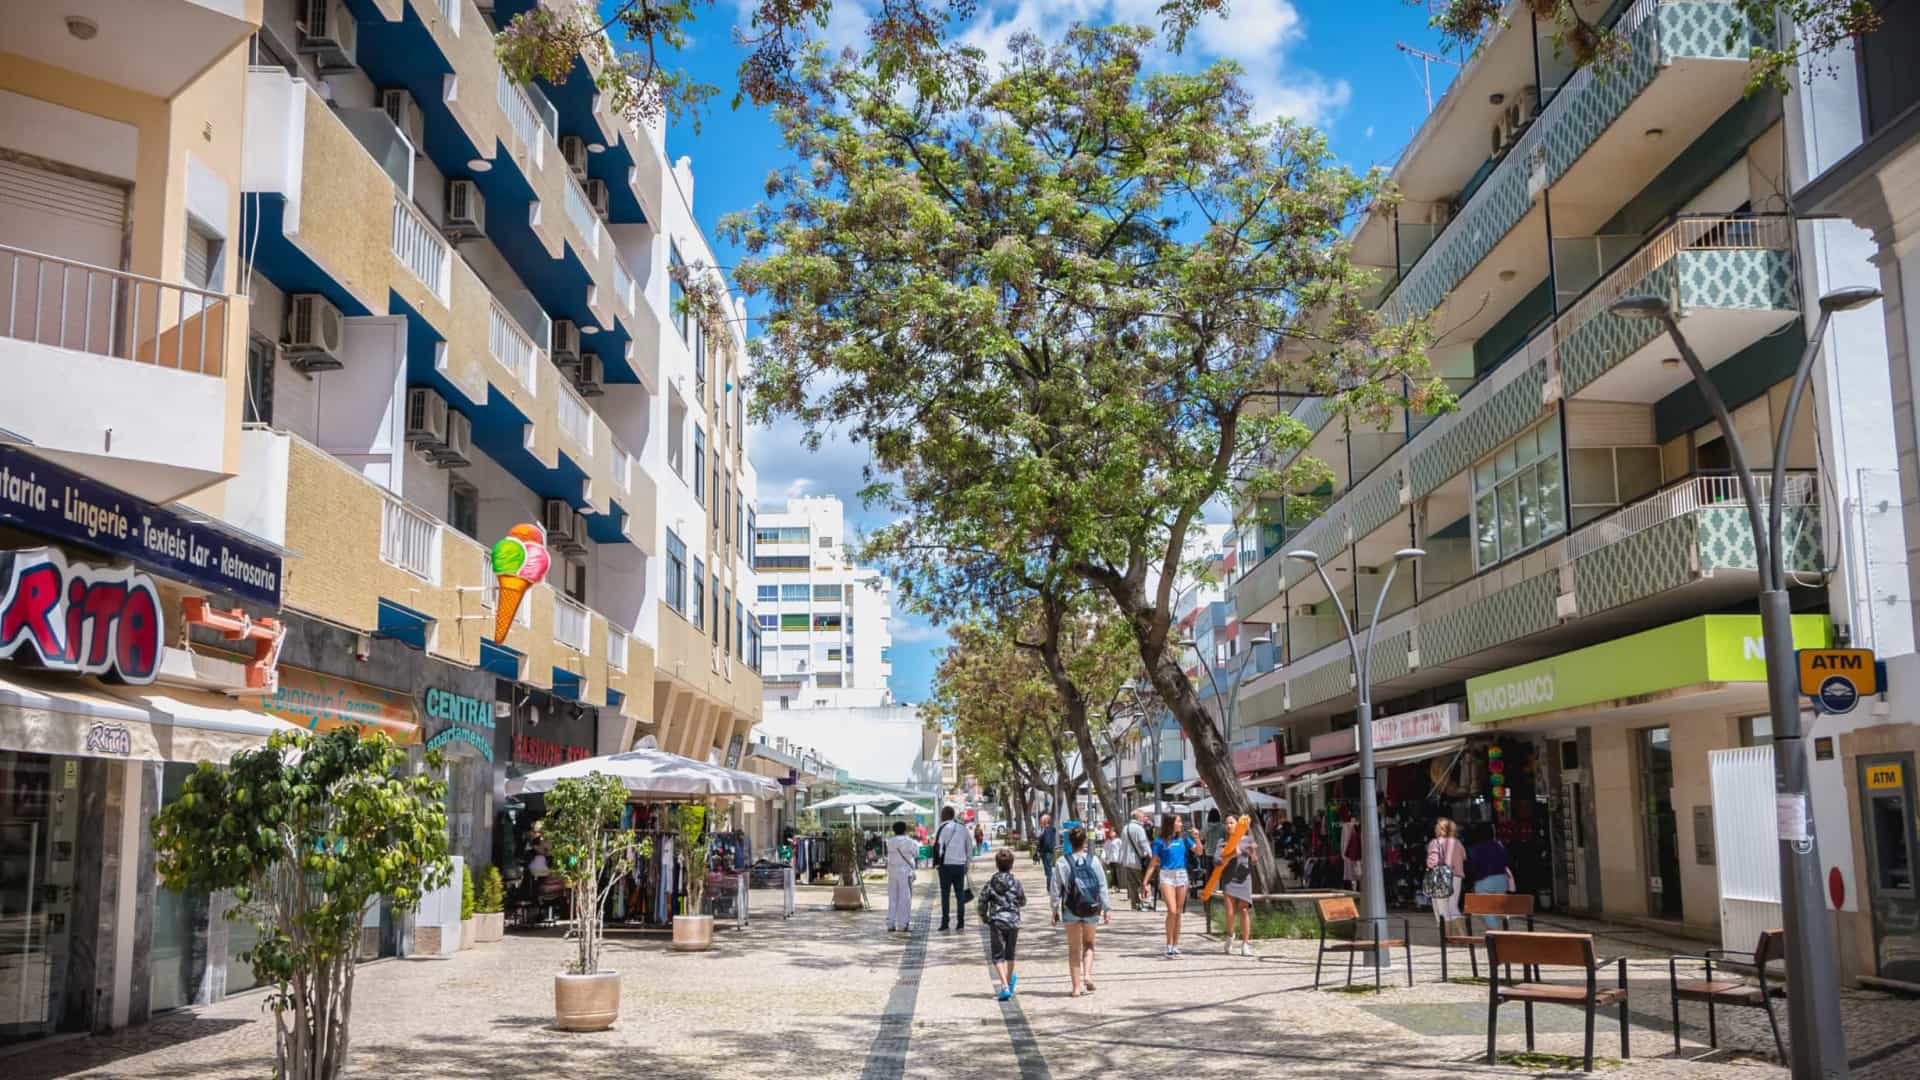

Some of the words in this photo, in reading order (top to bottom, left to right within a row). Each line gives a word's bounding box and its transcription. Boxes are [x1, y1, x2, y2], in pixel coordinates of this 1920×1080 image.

[0, 467, 46, 511] taria
[64, 486, 128, 538] Lingerie
[142, 515, 185, 560] Texteis
[189, 534, 210, 568] Lar
[221, 546, 275, 591] Retrosaria
[1811, 655, 1862, 669] ATM
[426, 688, 496, 729] CENTRAL
[1473, 687, 1507, 714] NOVO
[1508, 675, 1553, 708] BANCO
[426, 723, 494, 764] apartamentos
[513, 736, 561, 767] FASHION
[1873, 771, 1896, 784] ATM
